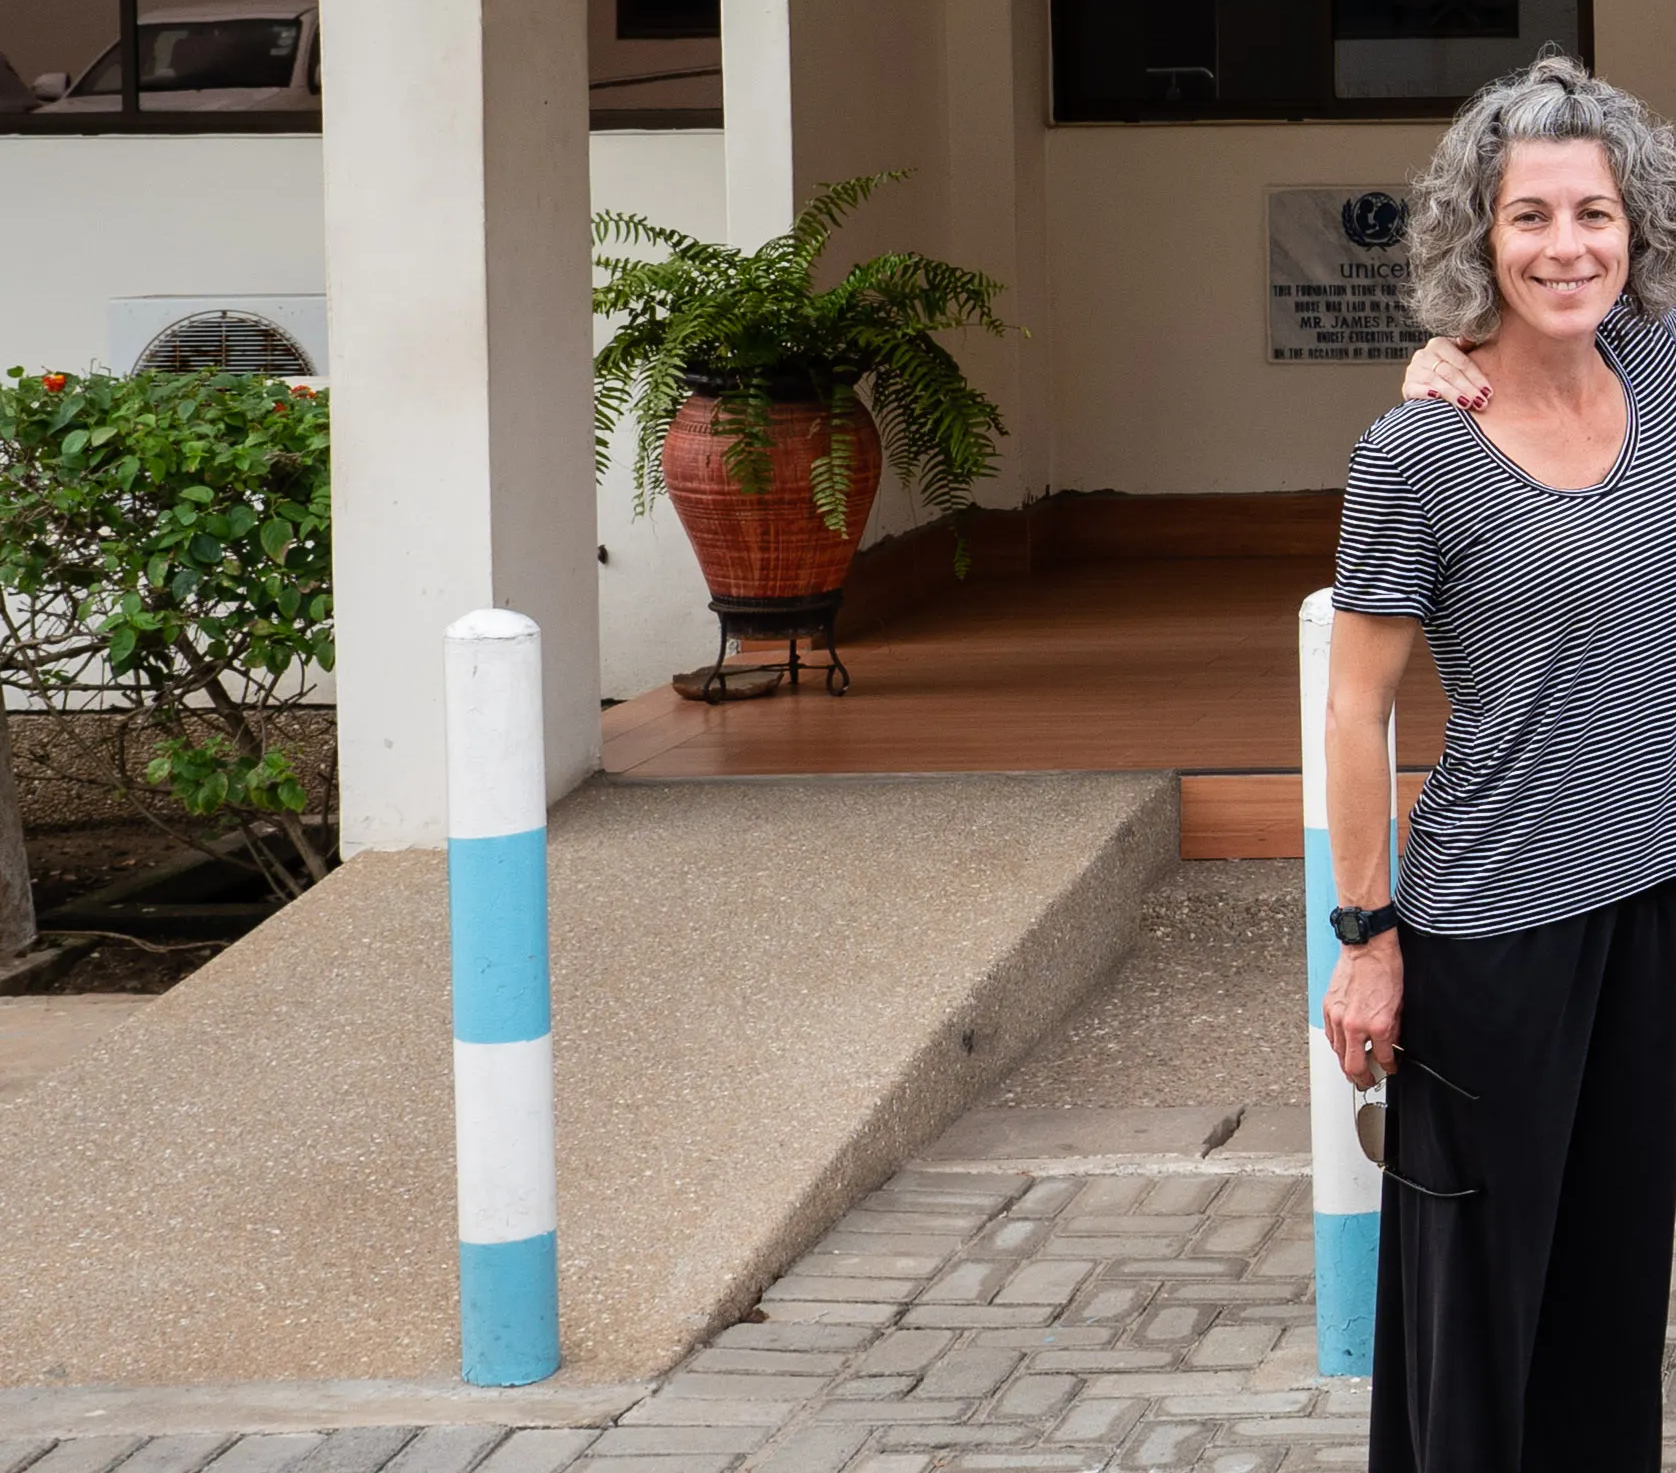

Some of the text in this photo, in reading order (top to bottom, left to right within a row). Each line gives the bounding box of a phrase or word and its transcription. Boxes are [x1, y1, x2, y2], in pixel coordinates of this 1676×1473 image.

[1273, 285, 1292, 297] THIS
[1296, 285, 1347, 297] FOUNDATION
[1351, 285, 1376, 297] STONE
[1381, 285, 1397, 297] FOR
[1325, 301, 1342, 313] WAS
[1346, 301, 1366, 313] LAID
[1370, 301, 1381, 313] ON
[1300, 316, 1326, 329] MR.
[1331, 316, 1380, 329] JAMES
[1317, 331, 1346, 343] UNICEF
[1349, 331, 1394, 343] EXECUTIVE
[1308, 347, 1350, 359] OCCASION
[1385, 347, 1409, 359] FIRST
